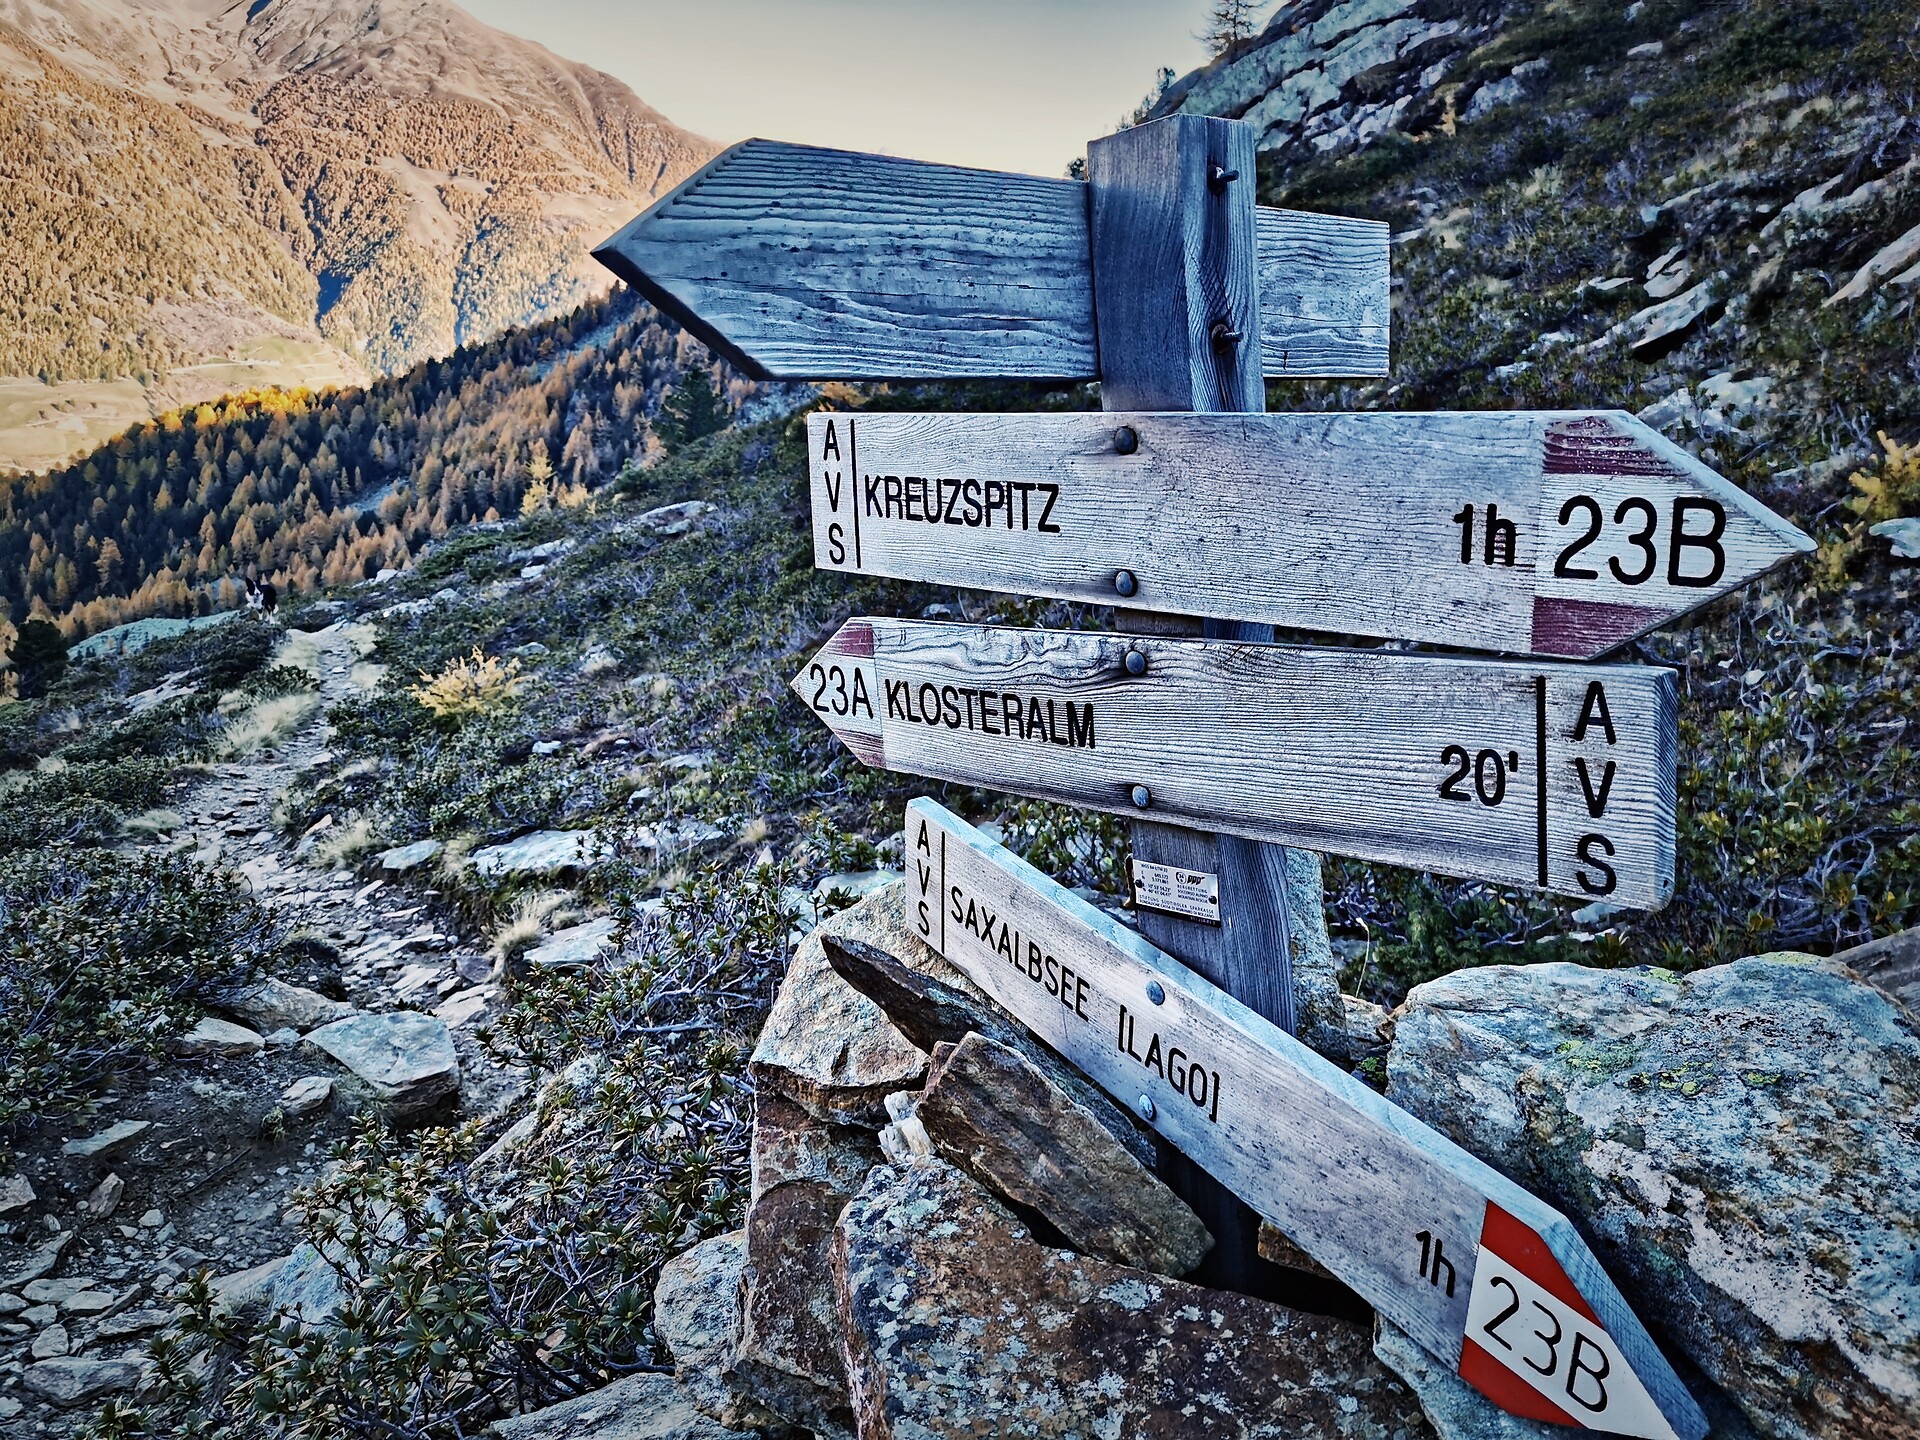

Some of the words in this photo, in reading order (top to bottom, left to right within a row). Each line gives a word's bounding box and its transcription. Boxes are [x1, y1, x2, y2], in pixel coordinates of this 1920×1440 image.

[823, 419, 845, 564] AVS
[865, 475, 1060, 533] KREUZSPITZ
[1453, 503, 1516, 567] 1h
[1554, 495, 1727, 587] 23B
[810, 663, 873, 719] 23A
[885, 679, 1096, 749] KLOSTERALM
[1439, 745, 1518, 806] 20'
[1573, 681, 1617, 896] AVS
[916, 819, 931, 937] AVS
[950, 886, 1090, 1022] SAXALBSEE
[1118, 1005, 1220, 1123] [LAGO]
[1415, 1230, 1456, 1299] 1h
[1483, 1276, 1610, 1413] 23B
